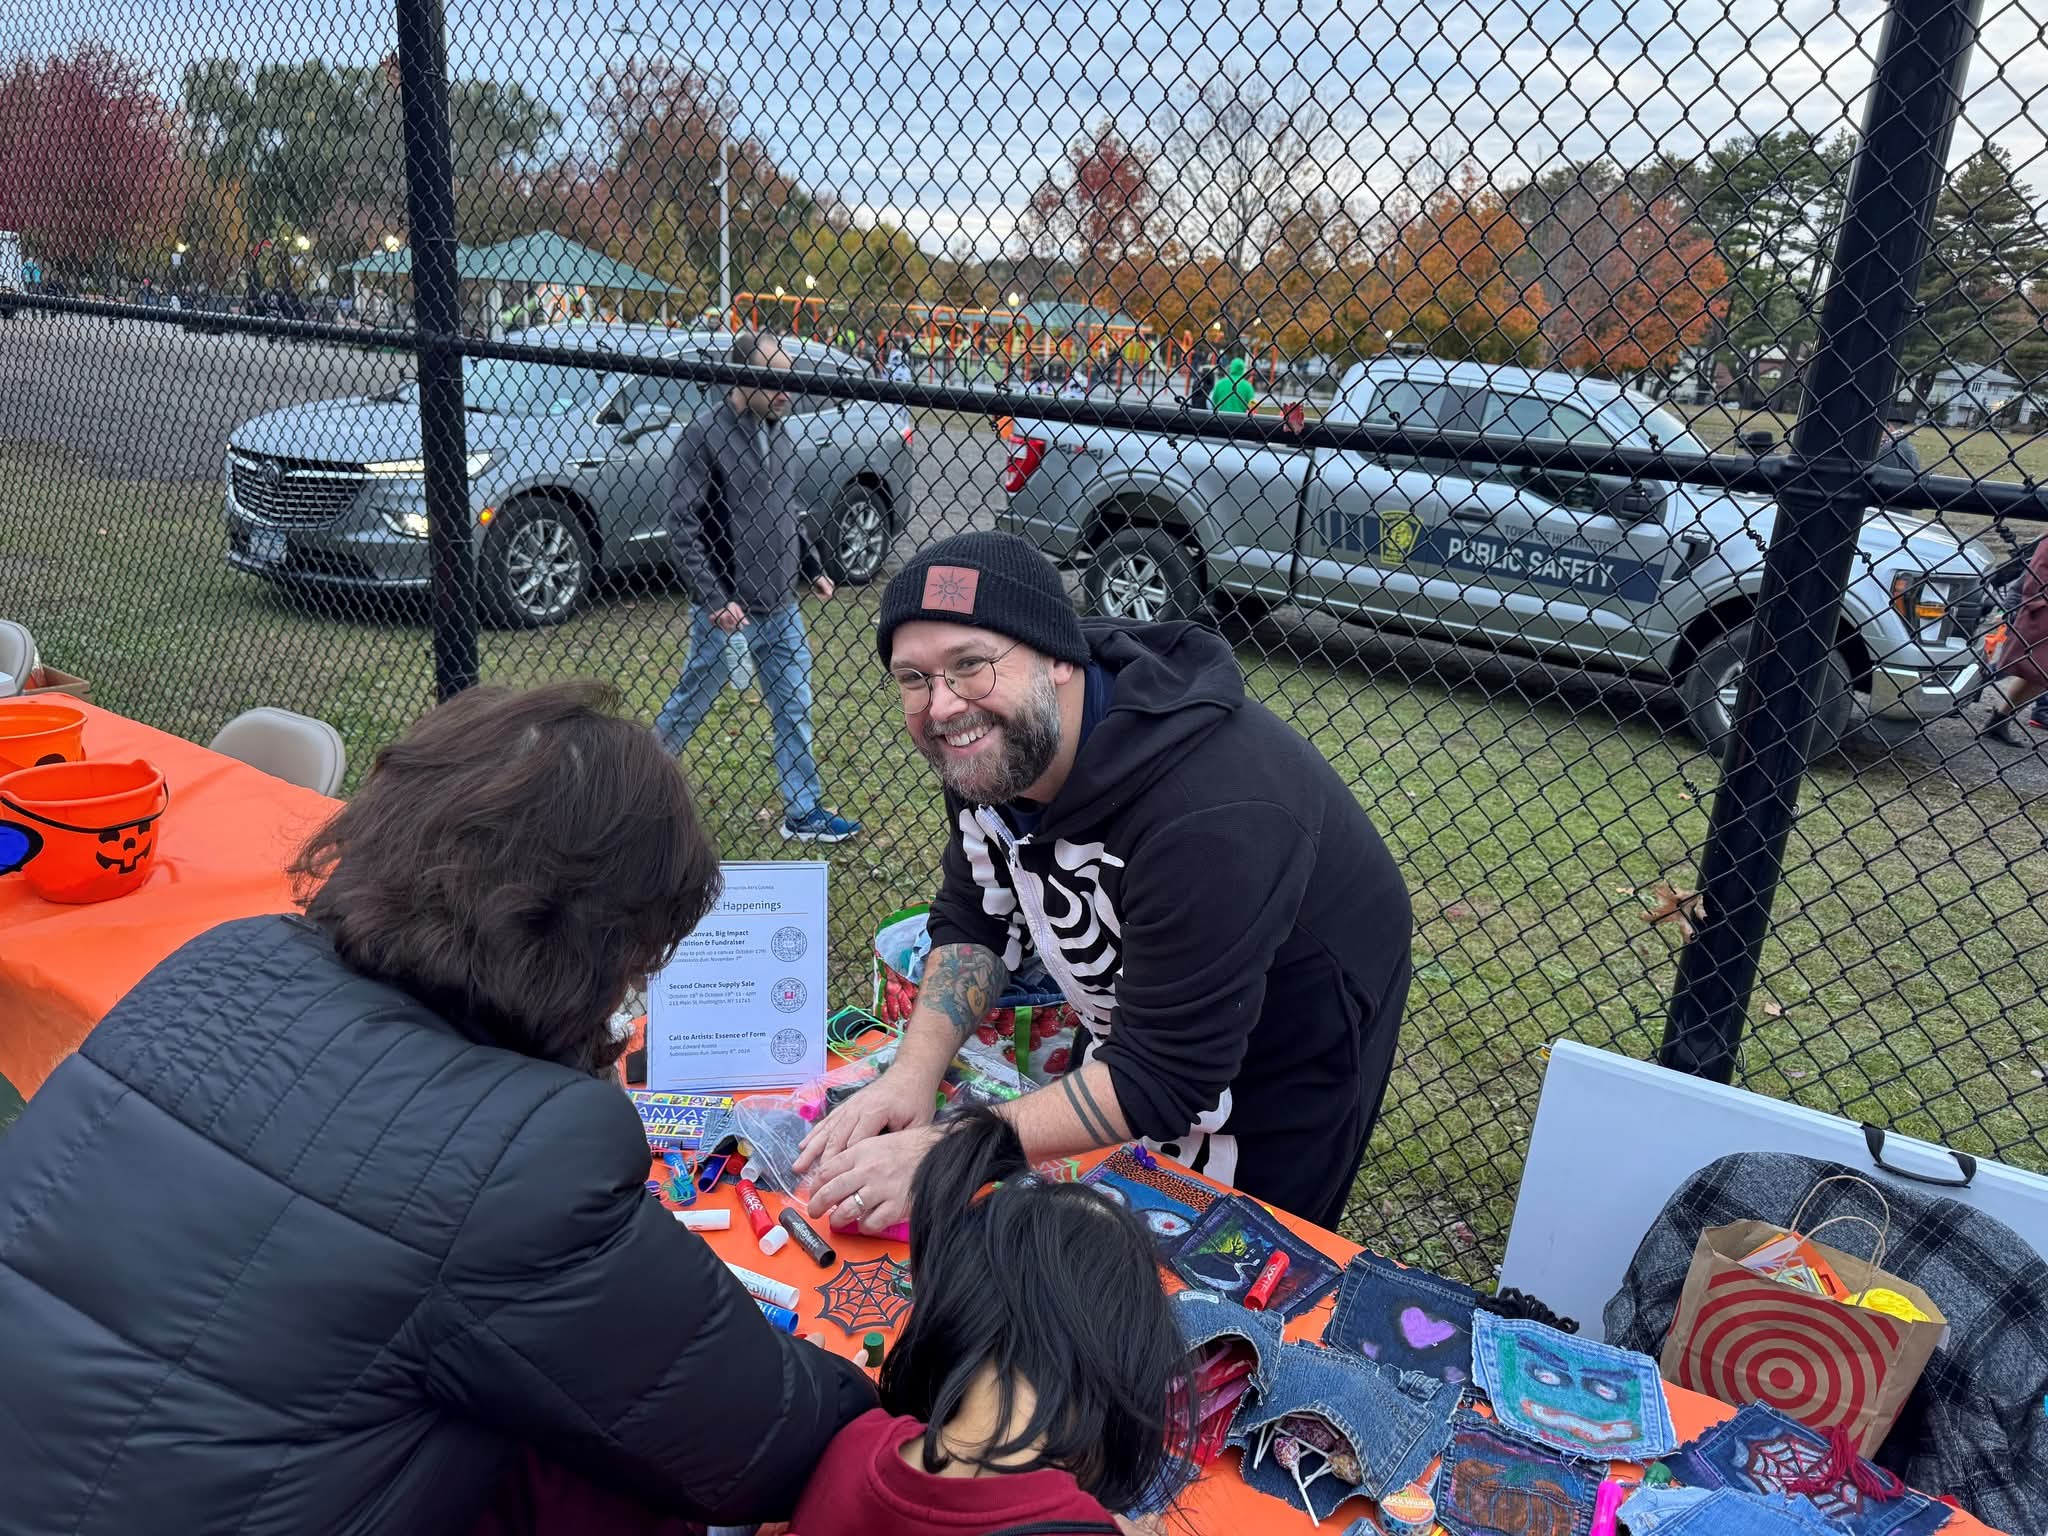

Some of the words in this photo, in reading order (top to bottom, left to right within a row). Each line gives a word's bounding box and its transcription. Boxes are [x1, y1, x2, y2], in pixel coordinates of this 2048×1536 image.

[1504, 524, 1536, 541] TOWN
[1449, 537, 1523, 571] PUBLIC
[1528, 554, 1614, 588] SAFETY
[723, 900, 781, 913] Happenings
[715, 930, 726, 938] Big
[712, 938, 745, 946] Fundraiser
[669, 982, 693, 990] Second
[718, 981, 740, 989] Supply
[638, 1106, 711, 1120] ANVAS
